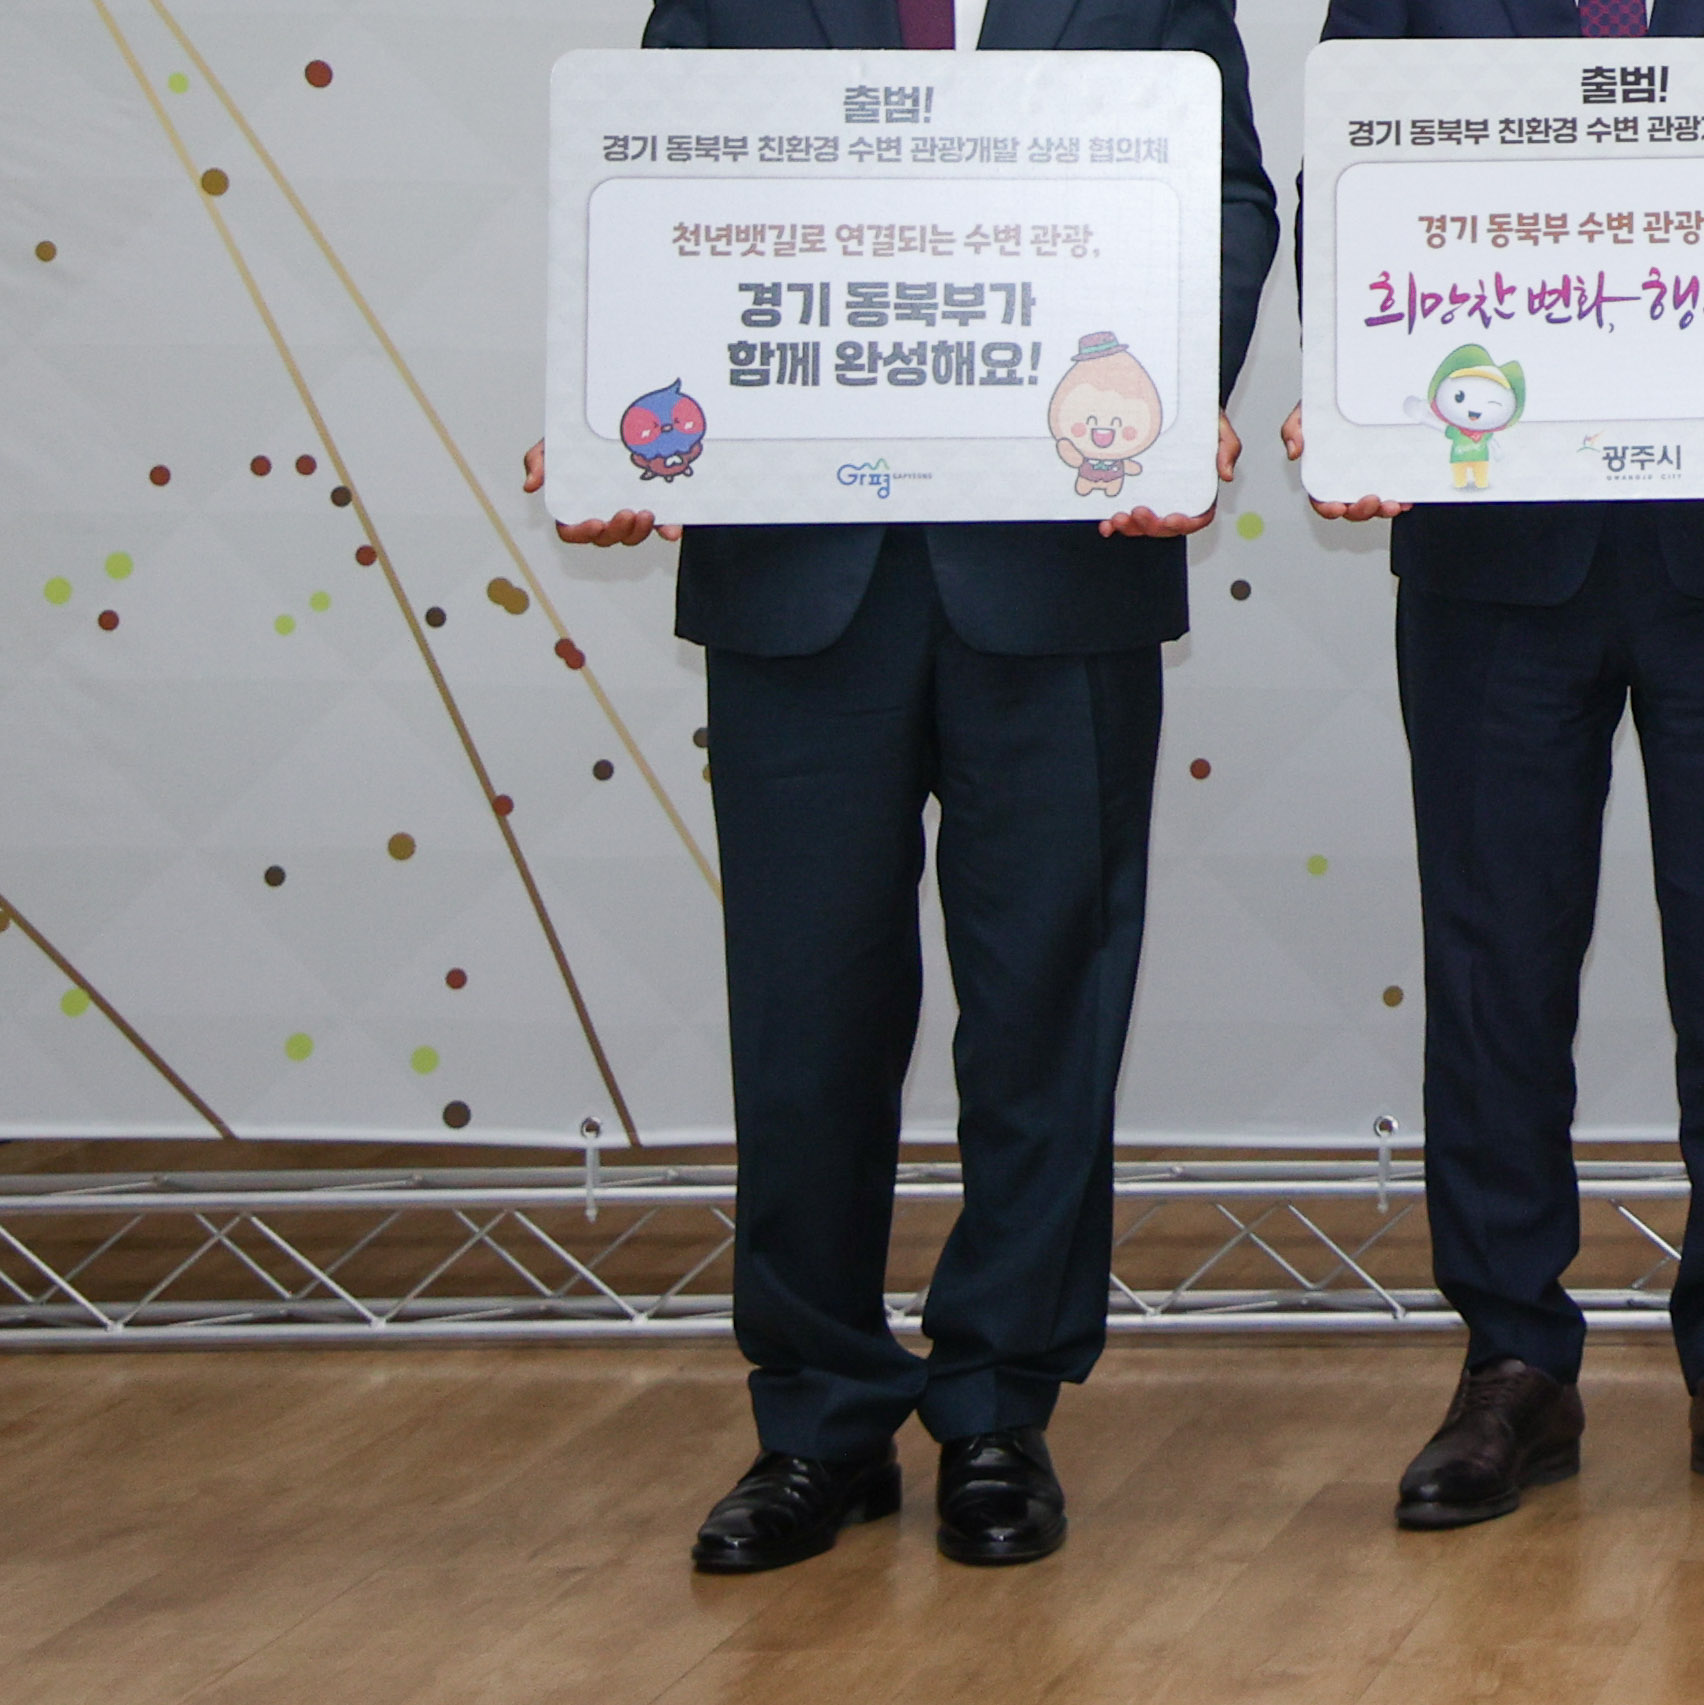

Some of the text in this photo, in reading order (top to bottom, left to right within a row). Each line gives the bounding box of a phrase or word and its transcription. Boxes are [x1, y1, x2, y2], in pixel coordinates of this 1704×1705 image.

[1581, 66, 1668, 104] 출범!
[843, 85, 933, 123] 출범!
[603, 135, 1168, 163] 경기 동북부 친환경 수변 관광개발 상생 협의체
[1349, 120, 1400, 146] 경기
[1410, 119, 1489, 145] 동북부
[1499, 117, 1577, 144] 친환경
[1587, 117, 1638, 143] 수변
[672, 222, 1099, 259] 천년뱃길로 연결되는 수변 관광,
[1418, 215, 1477, 249] 경기
[1487, 213, 1569, 248] 동북부
[1578, 212, 1633, 244] 수변
[738, 282, 1035, 328] 경기 동북부가
[1365, 271, 1516, 334] 희망찬
[728, 340, 1041, 387] 함께 완성해요!
[1602, 445, 1680, 472] 광주시
